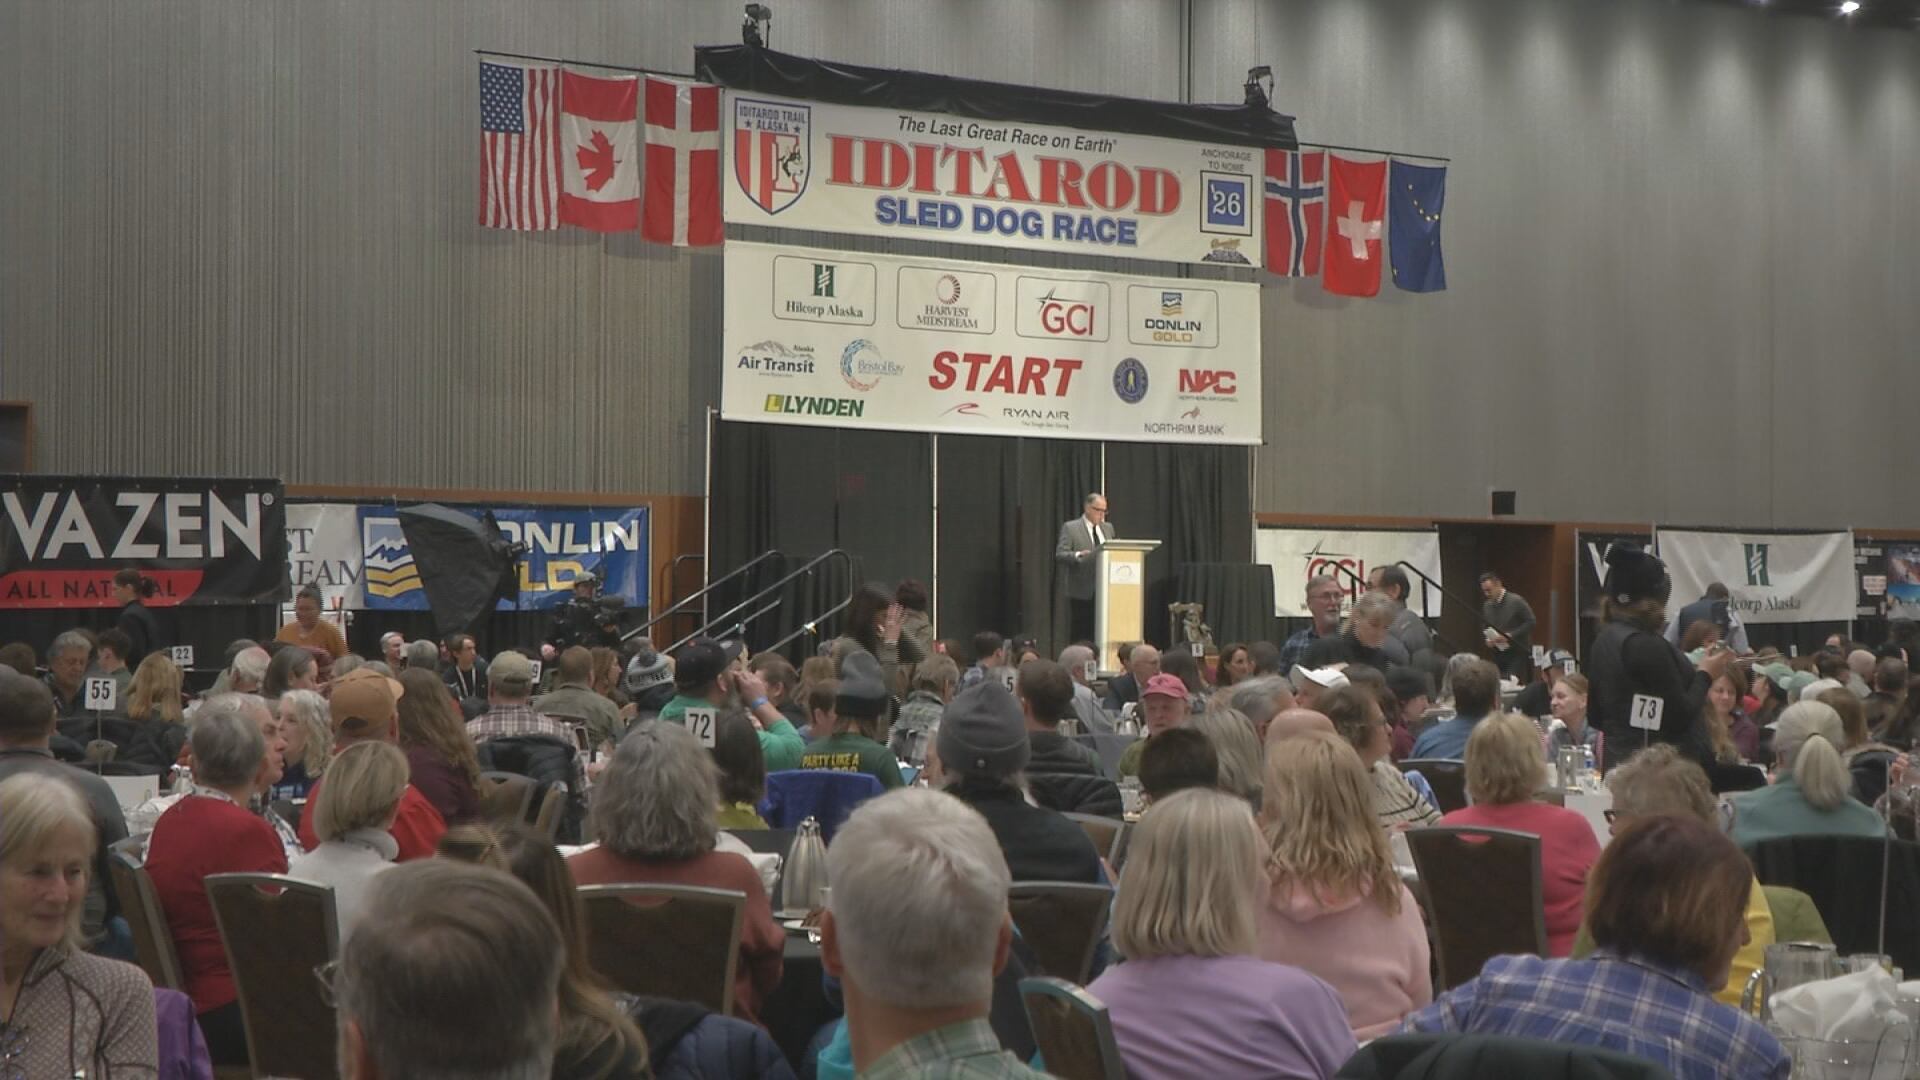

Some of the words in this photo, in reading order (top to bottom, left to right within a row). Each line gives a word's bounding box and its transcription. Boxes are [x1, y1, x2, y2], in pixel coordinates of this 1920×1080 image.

[782, 110, 805, 123] TRAIL
[757, 119, 789, 132] ALASKA
[899, 115, 926, 132] The
[930, 119, 963, 137] Last
[967, 123, 1007, 142] Great
[1011, 128, 1048, 146] Race
[1051, 135, 1071, 148] on
[1201, 148, 1252, 161] ANCHORAGE
[826, 133, 1182, 216] IDITAROD
[1208, 160, 1219, 169] TO
[1221, 162, 1244, 172] NOME
[875, 195, 964, 229] SLED
[972, 204, 1044, 238] DOG
[1052, 214, 1139, 246] RACE
[786, 300, 825, 317] Hilcorp
[827, 304, 864, 318] Alaska
[924, 305, 970, 317] HARVEST
[917, 315, 979, 329] MIDSTREAM
[1041, 303, 1094, 336] GCI
[1145, 318, 1202, 331] DONLIN
[1153, 332, 1193, 343] GOLD
[737, 356, 761, 369] Air
[763, 357, 815, 373] Transit
[929, 351, 1083, 397] START
[1179, 368, 1237, 394] NAC
[784, 395, 864, 417] LYNDEN
[1003, 408, 1042, 419] RYAN
[1046, 411, 1070, 421] AIR
[1144, 423, 1195, 434] NORTHRIM
[1199, 425, 1225, 435] BANK
[7, 579, 52, 599] ALL
[63, 579, 177, 599] NATAL
[175, 647, 189, 660] 22
[91, 680, 110, 700] 55
[1638, 698, 1657, 720] 73
[689, 713, 711, 739] 72
[803, 753, 830, 767] PARTY
[831, 753, 850, 766] LIKE
[851, 752, 860, 766] A
